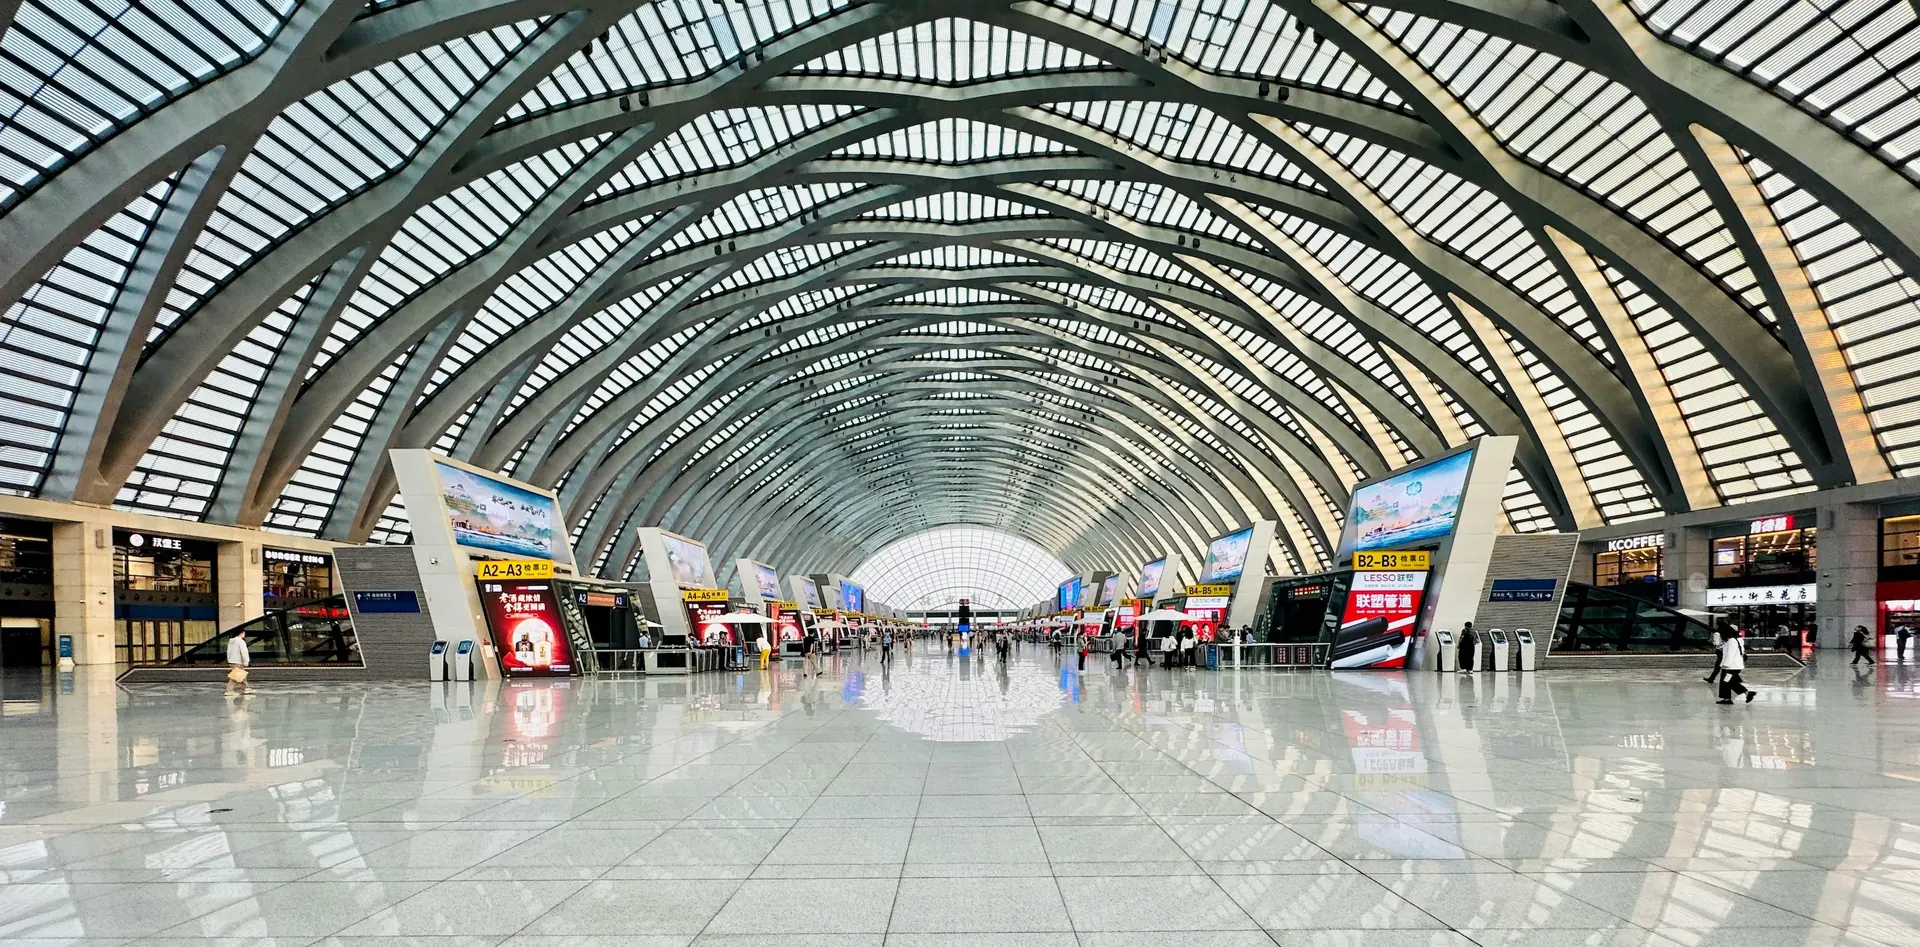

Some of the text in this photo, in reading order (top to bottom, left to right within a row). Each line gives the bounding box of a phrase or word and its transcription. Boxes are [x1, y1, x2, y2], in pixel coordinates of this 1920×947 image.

[152, 537, 182, 550] 汉堡王
[1608, 534, 1665, 551] KCOFFEE
[265, 550, 325, 564] BURGER KING
[1358, 554, 1425, 568] B2-B3 检票口
[482, 563, 522, 577] A2-A3
[524, 563, 548, 571] 检票口
[1363, 573, 1396, 582] LESSO
[687, 591, 711, 600] A4-A5
[1189, 586, 1212, 595] B4-B5
[1717, 587, 1807, 602] 十八街麻花店
[578, 593, 587, 603] A2
[615, 596, 623, 605] A3
[1355, 593, 1412, 609] 联塑管道
